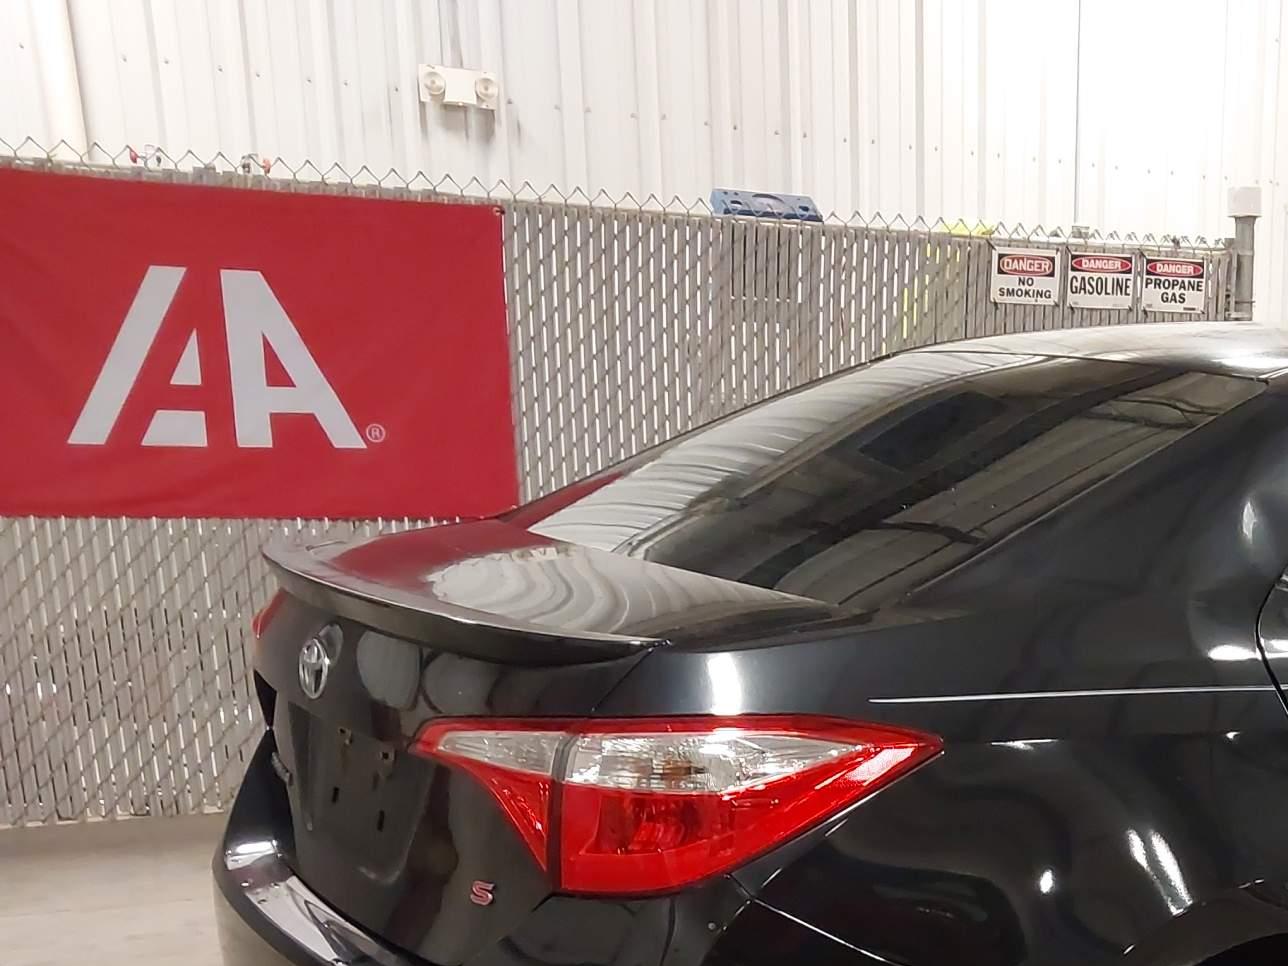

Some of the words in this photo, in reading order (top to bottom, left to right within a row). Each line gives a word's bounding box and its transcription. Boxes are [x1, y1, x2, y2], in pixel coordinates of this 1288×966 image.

[1003, 257, 1050, 274] DANGER
[1082, 258, 1121, 270] DANGER
[1156, 263, 1194, 275] DANGER
[1018, 277, 1034, 287] NO
[1070, 275, 1132, 296] GASOLINE
[1145, 277, 1204, 292] PROPANE
[998, 287, 1052, 299] SMOKING
[1160, 292, 1186, 304] GAS
[470, 880, 495, 906] S
